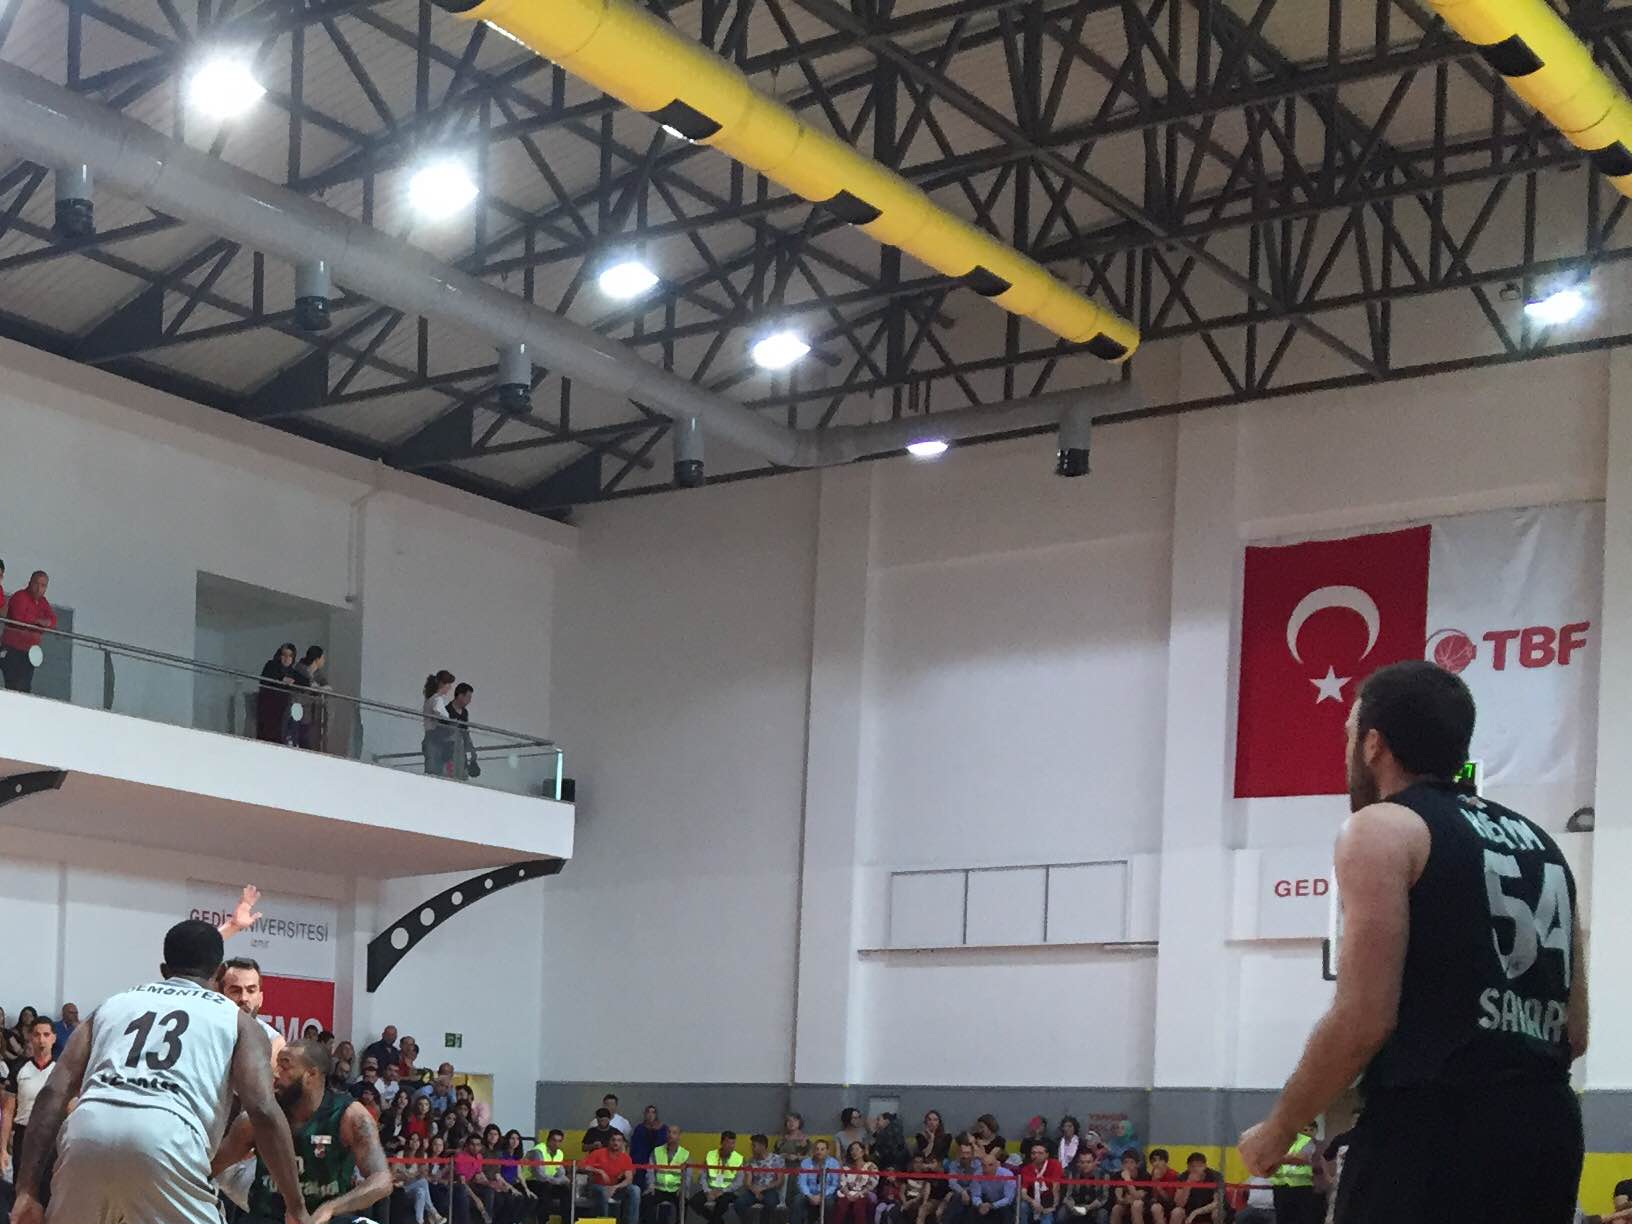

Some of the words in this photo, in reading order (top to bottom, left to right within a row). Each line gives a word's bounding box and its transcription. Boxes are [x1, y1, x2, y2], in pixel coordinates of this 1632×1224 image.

[1483, 621, 1591, 672] TBF
[1483, 848, 1571, 990] 54
[124, 1010, 190, 1070] 13
